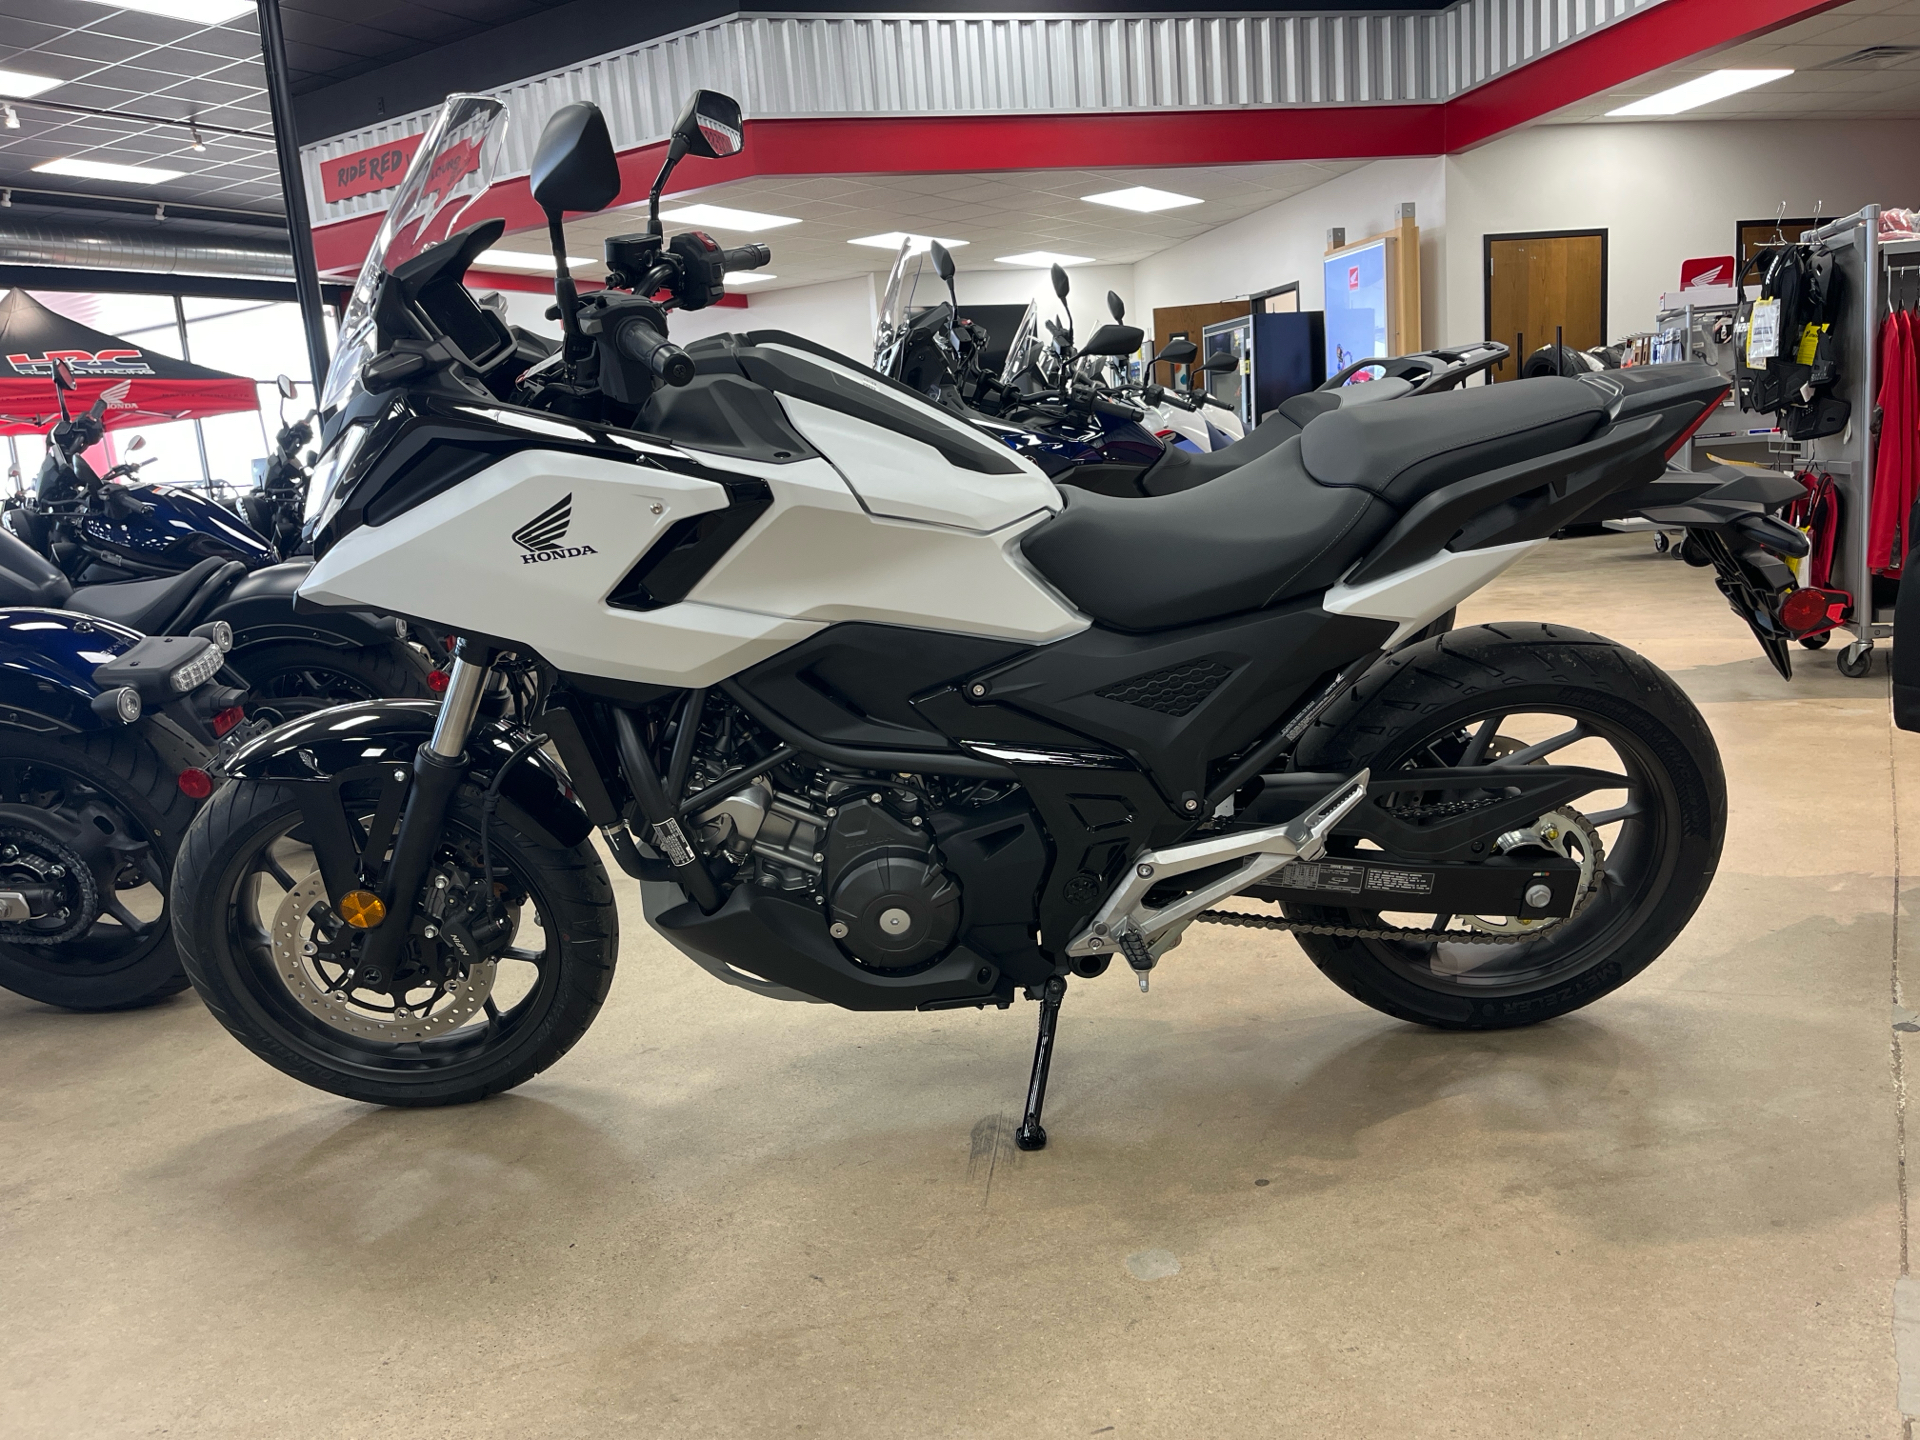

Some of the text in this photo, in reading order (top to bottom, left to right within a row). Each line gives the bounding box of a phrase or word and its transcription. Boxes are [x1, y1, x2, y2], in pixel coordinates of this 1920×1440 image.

[337, 158, 368, 188] RIDE
[369, 151, 402, 182] RED
[6, 350, 150, 372] HRC
[520, 545, 598, 564] HONDA
